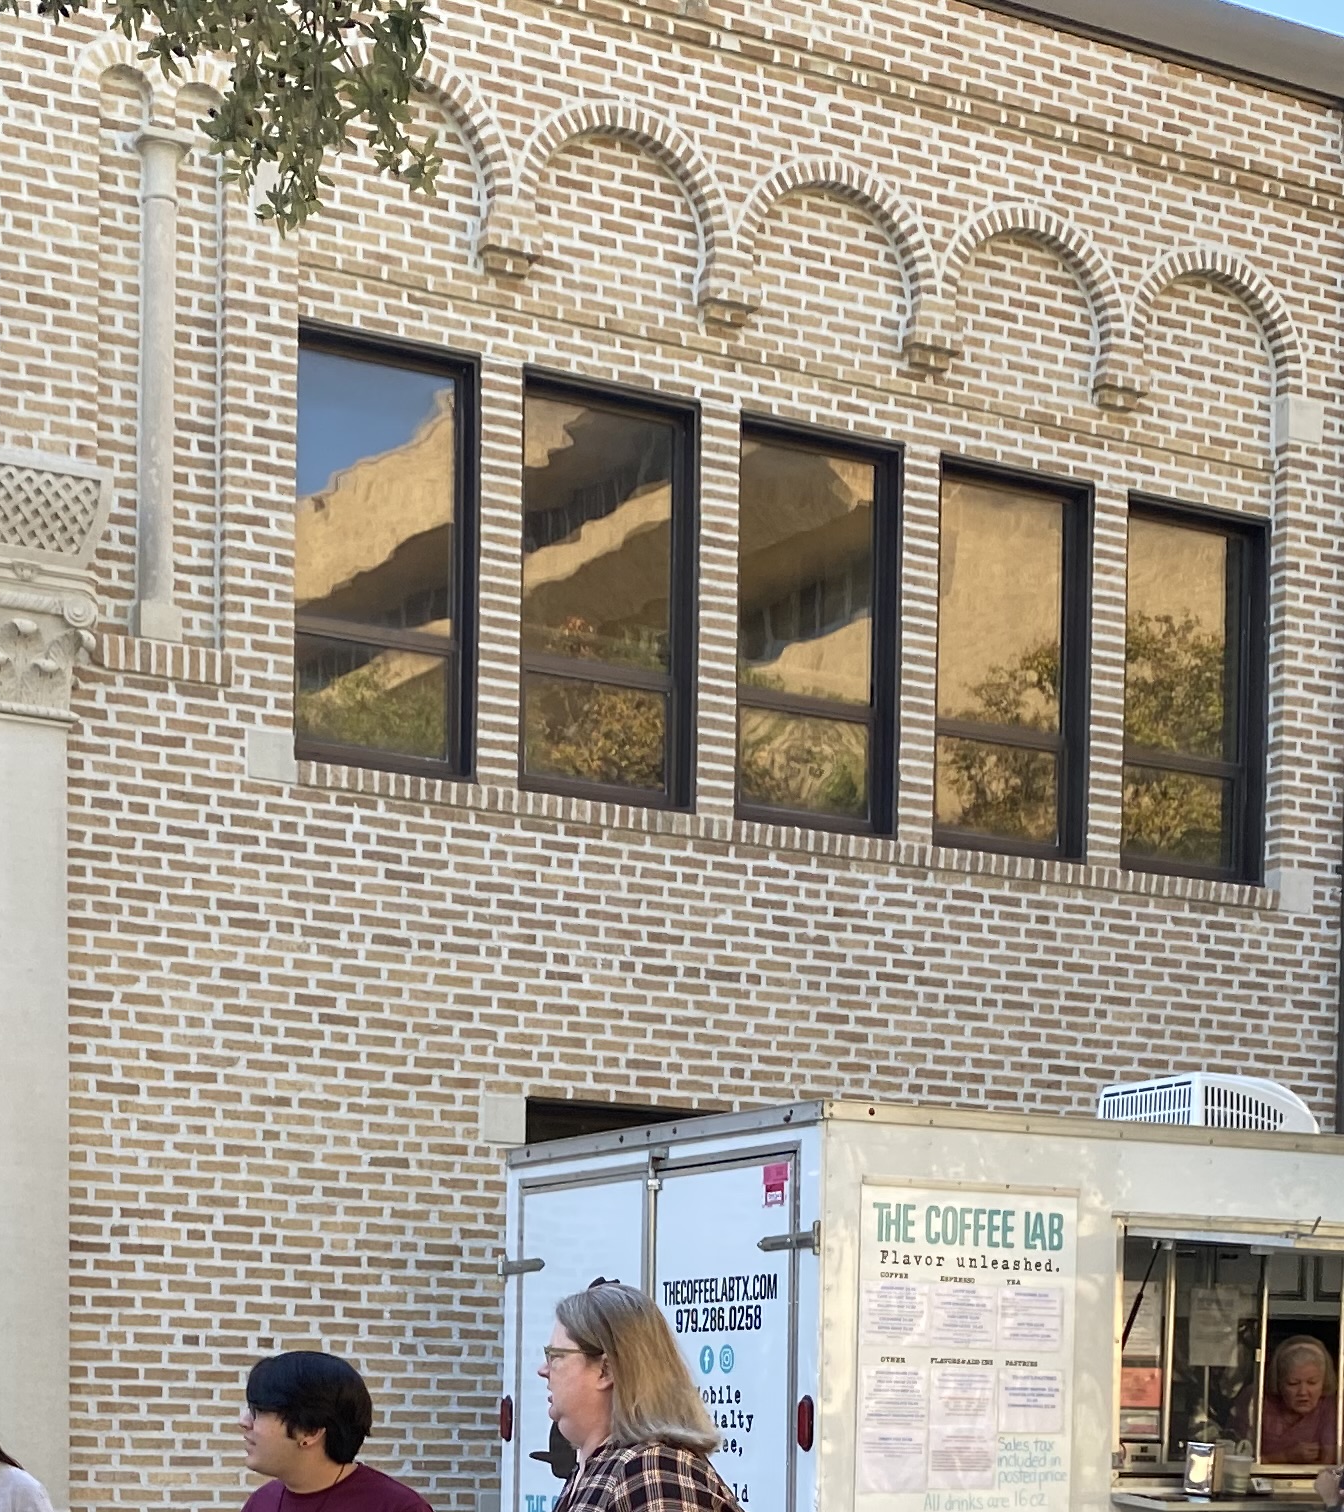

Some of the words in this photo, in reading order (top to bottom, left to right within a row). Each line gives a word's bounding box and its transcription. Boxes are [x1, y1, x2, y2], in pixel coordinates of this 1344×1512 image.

[873, 1202, 916, 1243] THE
[925, 1205, 1015, 1248] COFFEE
[1024, 1211, 1064, 1251] LAB
[880, 1250, 945, 1267] Flavor
[956, 1255, 1060, 1272] unleashed.
[663, 1274, 777, 1306] THECOFFEELABTX.COM
[676, 1305, 762, 1333] 979.286.0258
[697, 1385, 741, 1404] obile
[998, 1437, 1029, 1451] Sales
[1033, 1440, 1054, 1451] tax
[997, 1453, 1046, 1467] included
[1051, 1455, 1062, 1467] in
[998, 1469, 1036, 1490] posted
[1038, 1470, 1067, 1490] price
[924, 1494, 940, 1511] All
[944, 1493, 984, 1511] drinks
[987, 1496, 1010, 1509] are
[1014, 1491, 1028, 1507] 16
